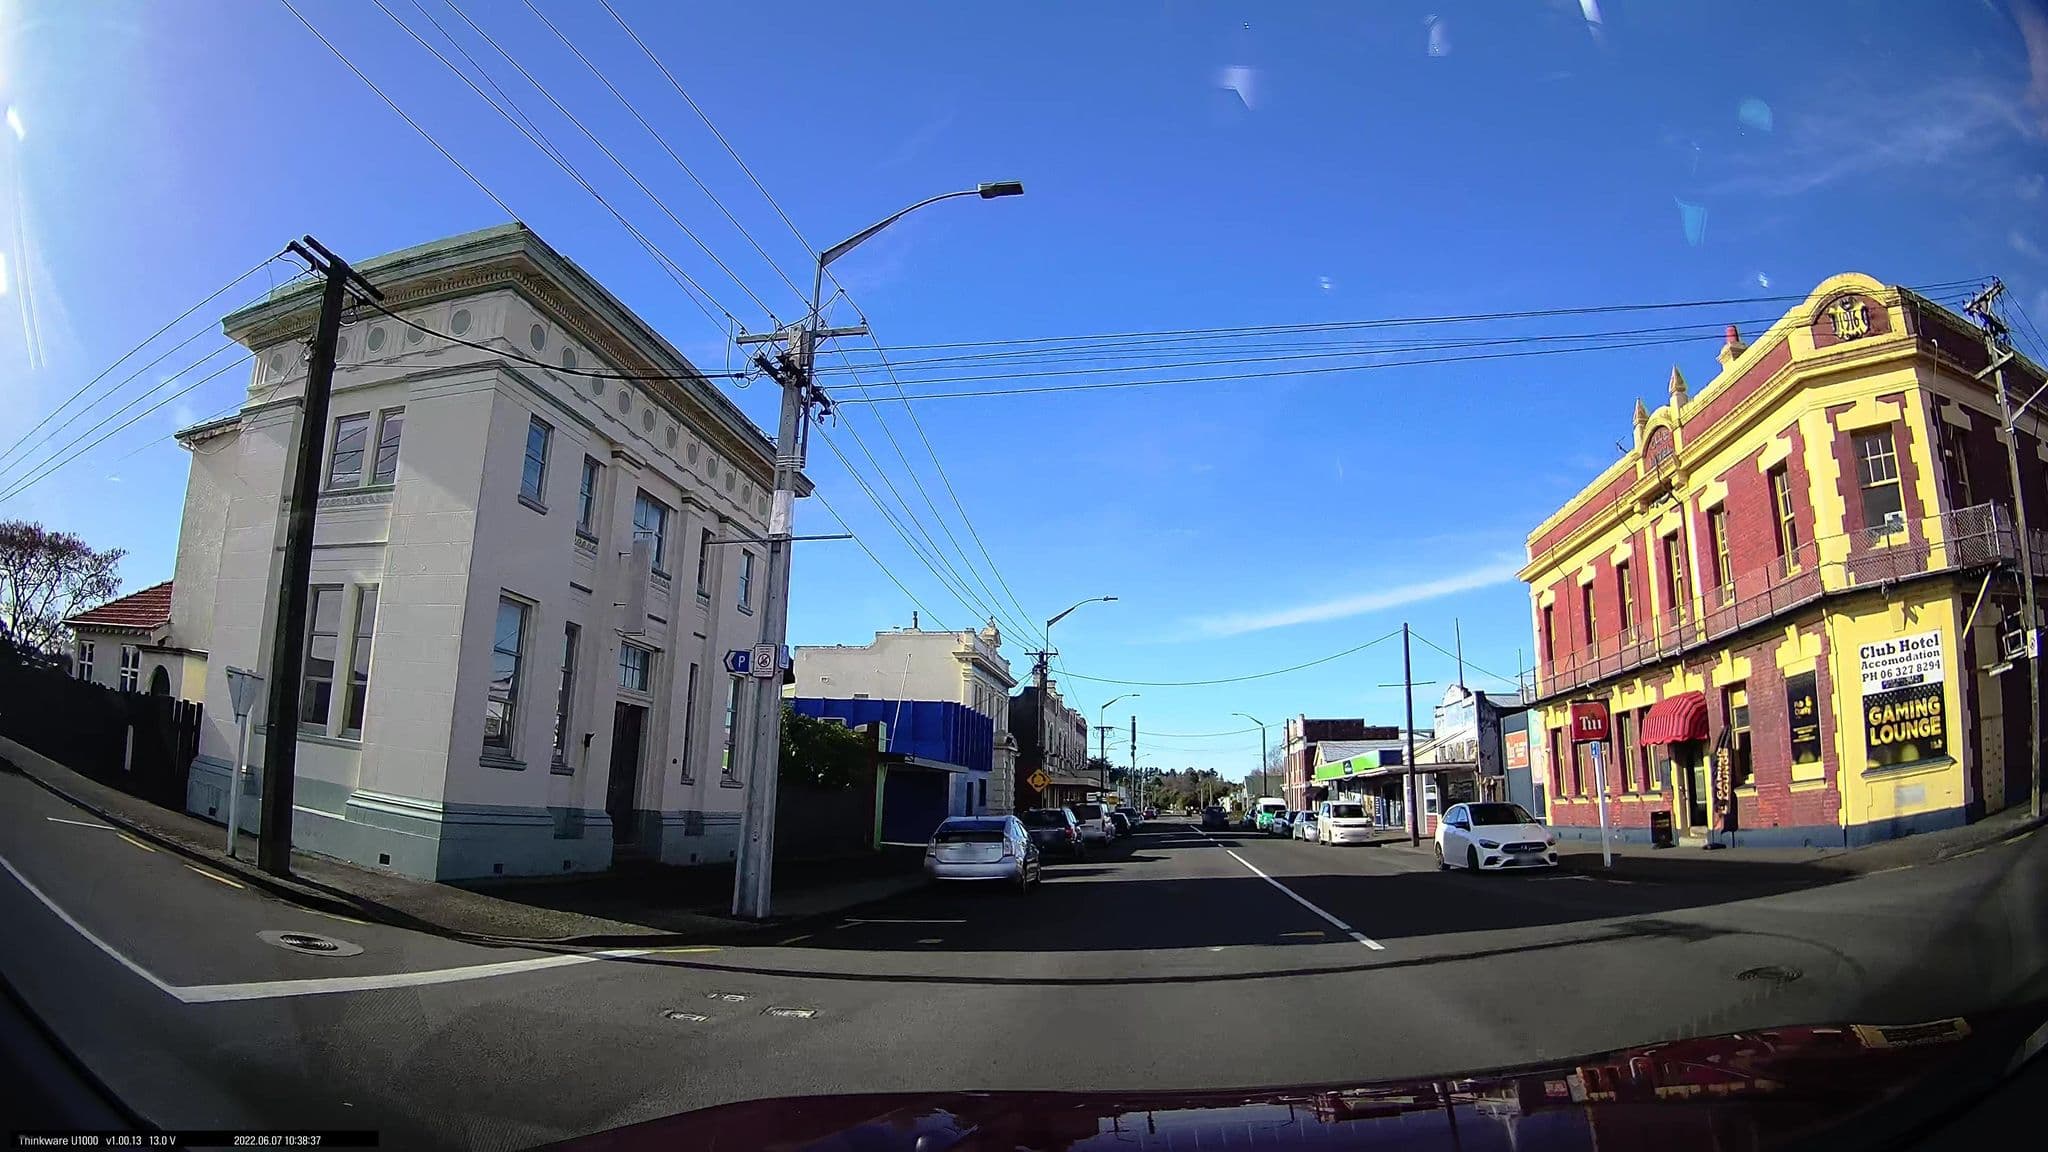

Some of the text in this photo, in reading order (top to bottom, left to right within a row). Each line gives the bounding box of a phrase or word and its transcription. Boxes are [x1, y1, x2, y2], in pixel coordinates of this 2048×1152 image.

[1860, 633, 1940, 660] Club Hotel
[738, 655, 746, 668] P
[1861, 650, 1940, 670] Accomodation
[1862, 671, 1878, 683] PH
[1880, 668, 1893, 679] 06
[1895, 664, 1913, 677] 327
[1917, 659, 1941, 674] 8294
[1868, 695, 1941, 726] GAMING
[1870, 716, 1942, 747] LOUNGE
